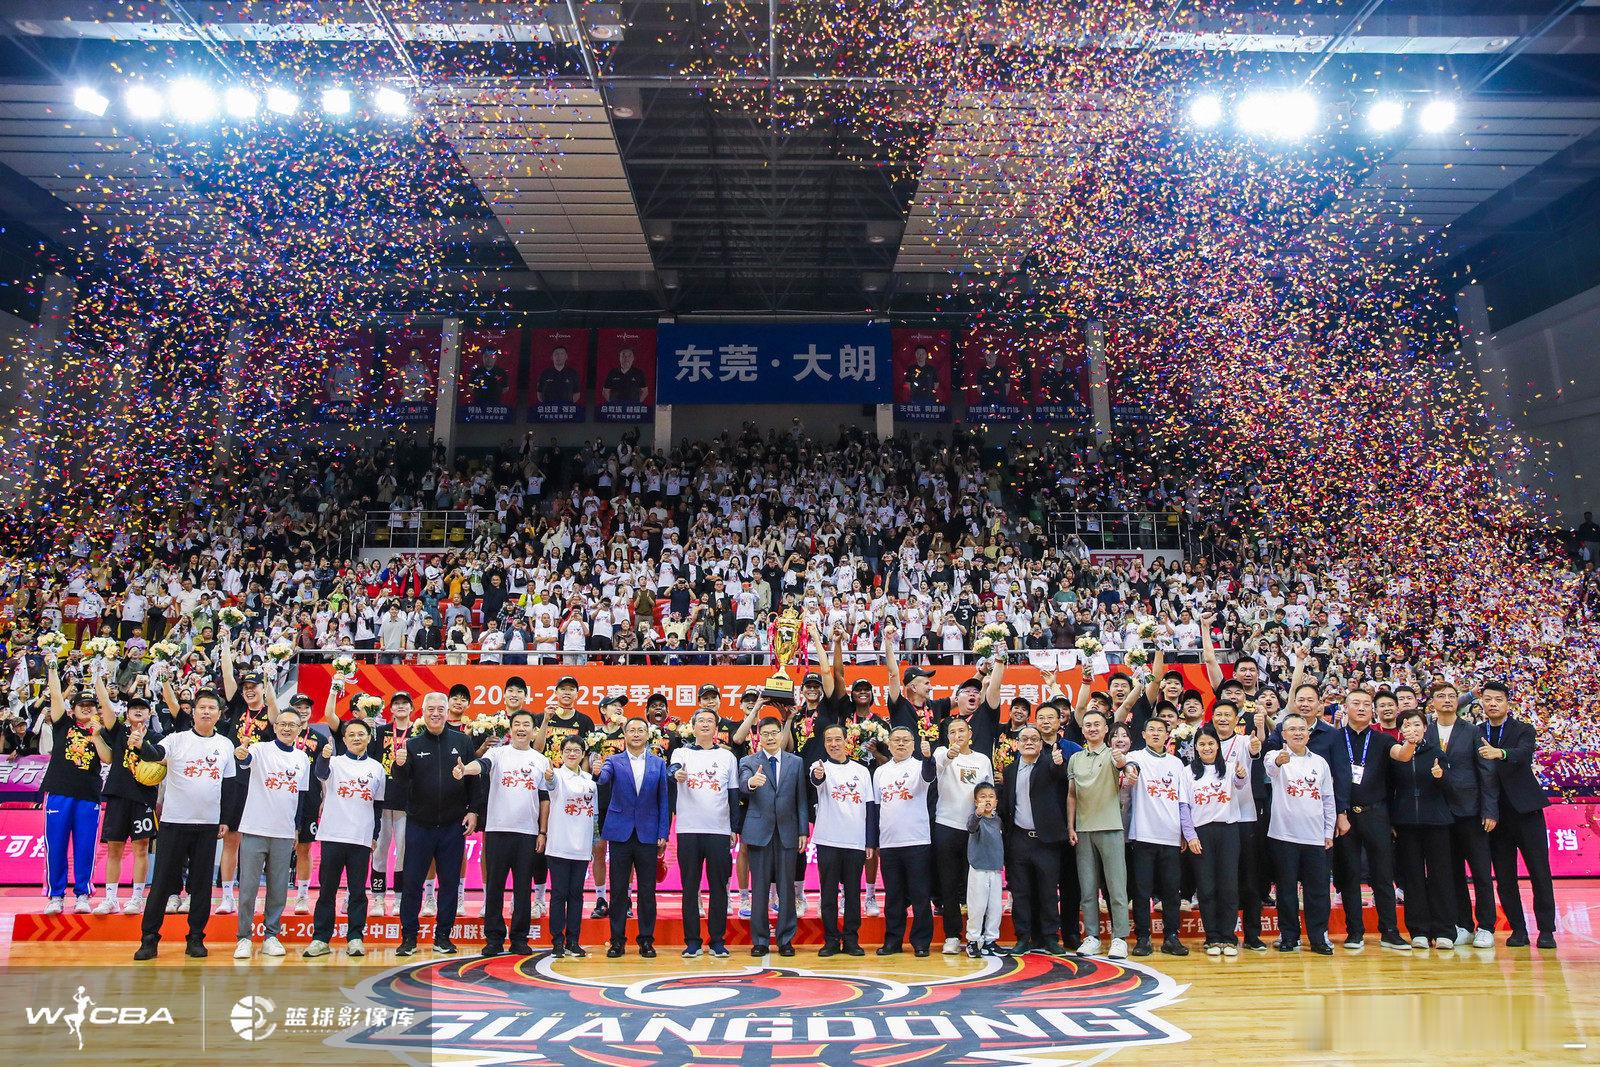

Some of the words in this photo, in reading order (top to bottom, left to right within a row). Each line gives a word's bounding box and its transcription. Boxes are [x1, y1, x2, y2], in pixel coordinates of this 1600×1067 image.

[674, 344, 876, 383] 东莞·大朗
[961, 609, 969, 621] 3
[133, 817, 153, 834] 30
[309, 821, 318, 835] 6
[373, 878, 384, 888] 22
[712, 1009, 1014, 1018] BASKETBALL
[368, 1008, 1149, 1042] GUANGDONG
